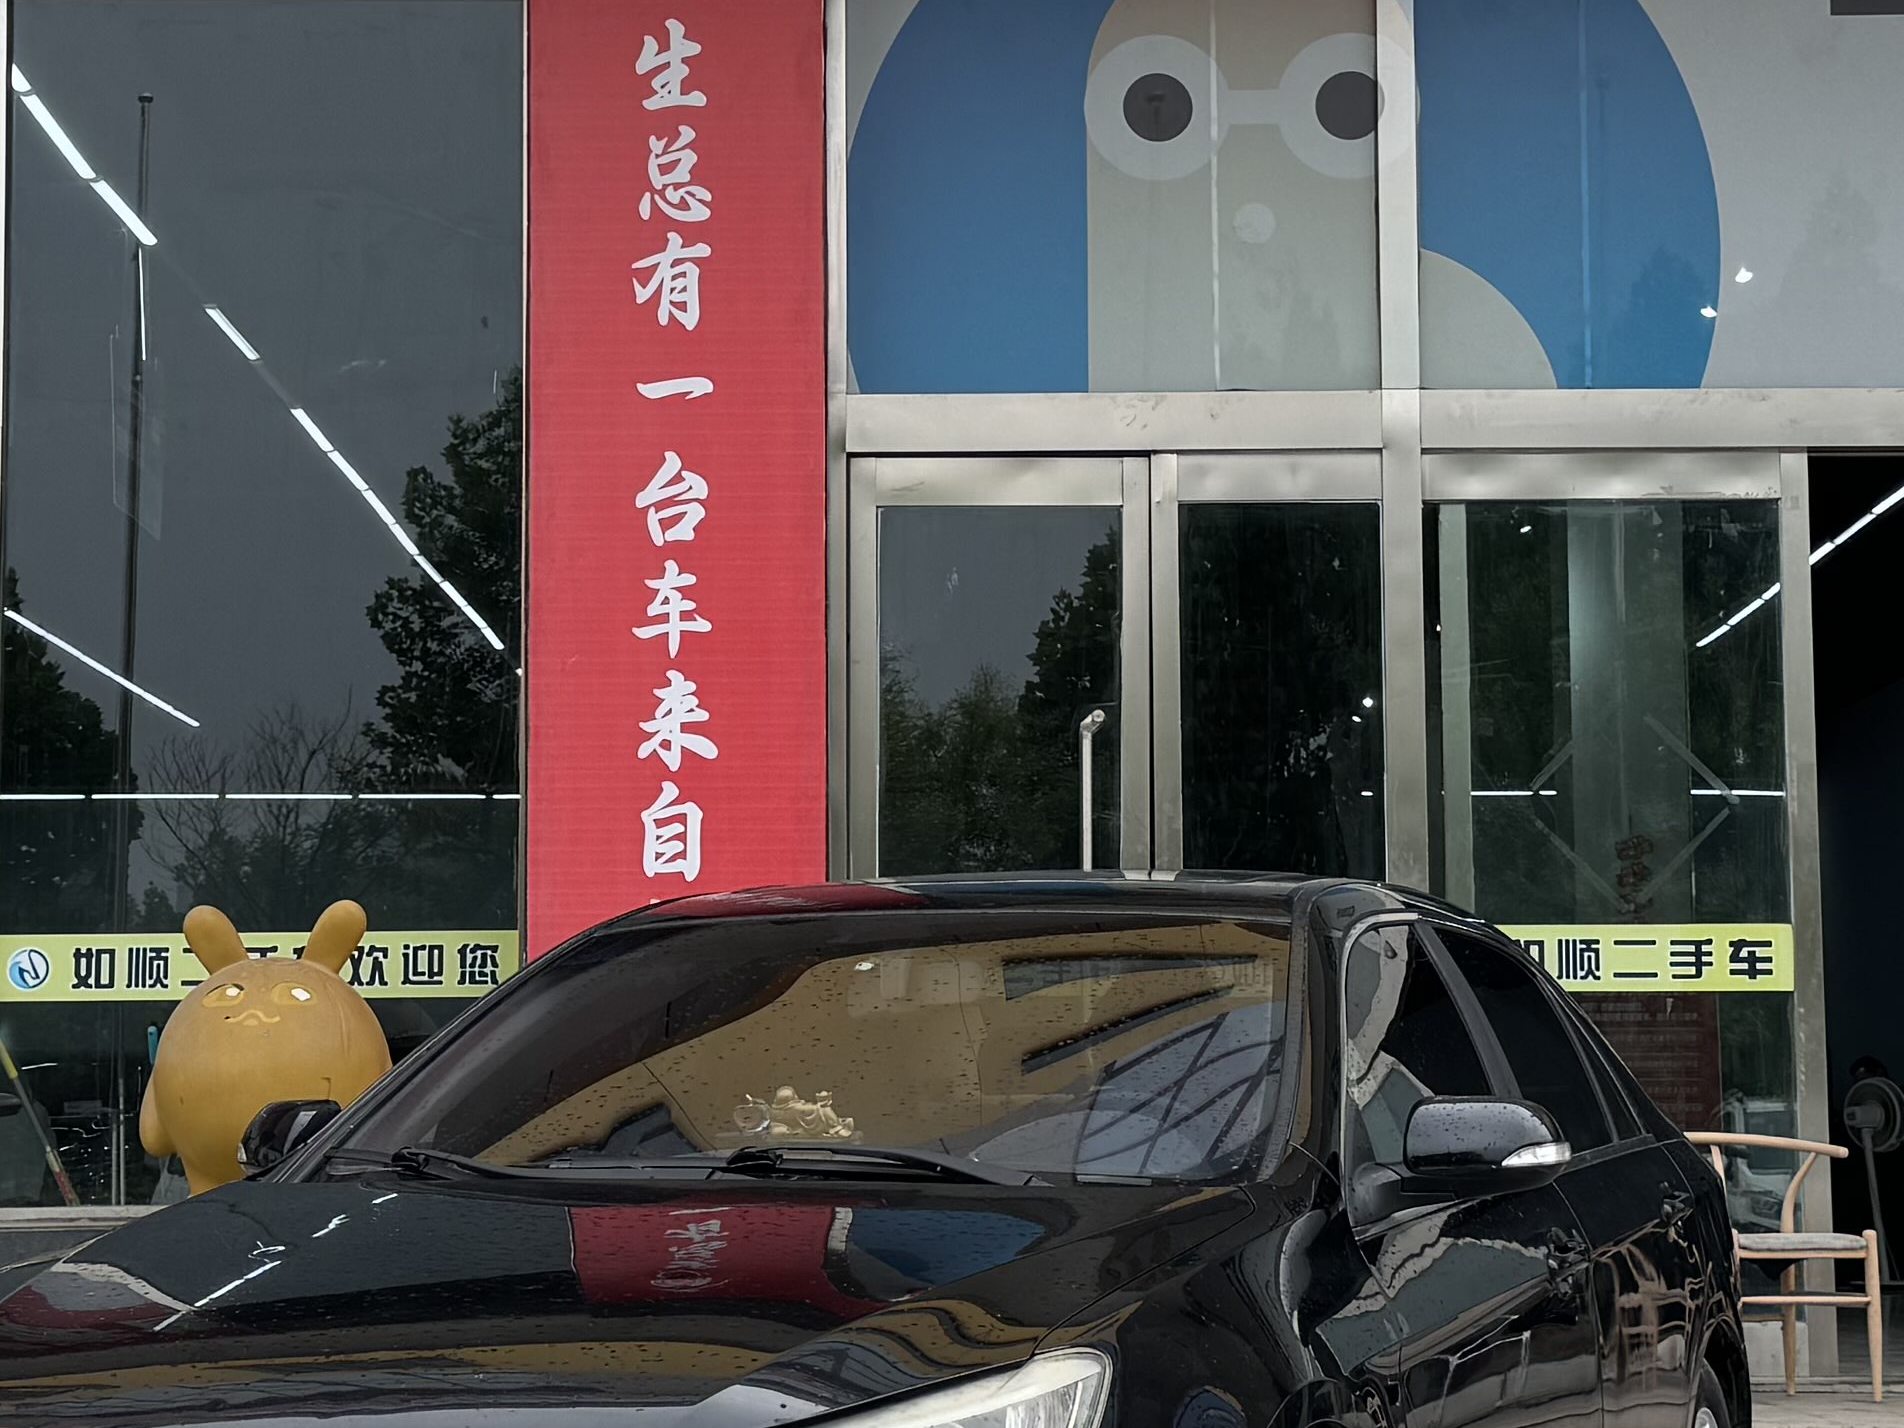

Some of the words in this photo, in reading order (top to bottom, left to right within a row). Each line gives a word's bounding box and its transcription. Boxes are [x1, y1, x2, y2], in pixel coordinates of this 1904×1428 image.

[71, 942, 500, 991] 如顺欢迎您
